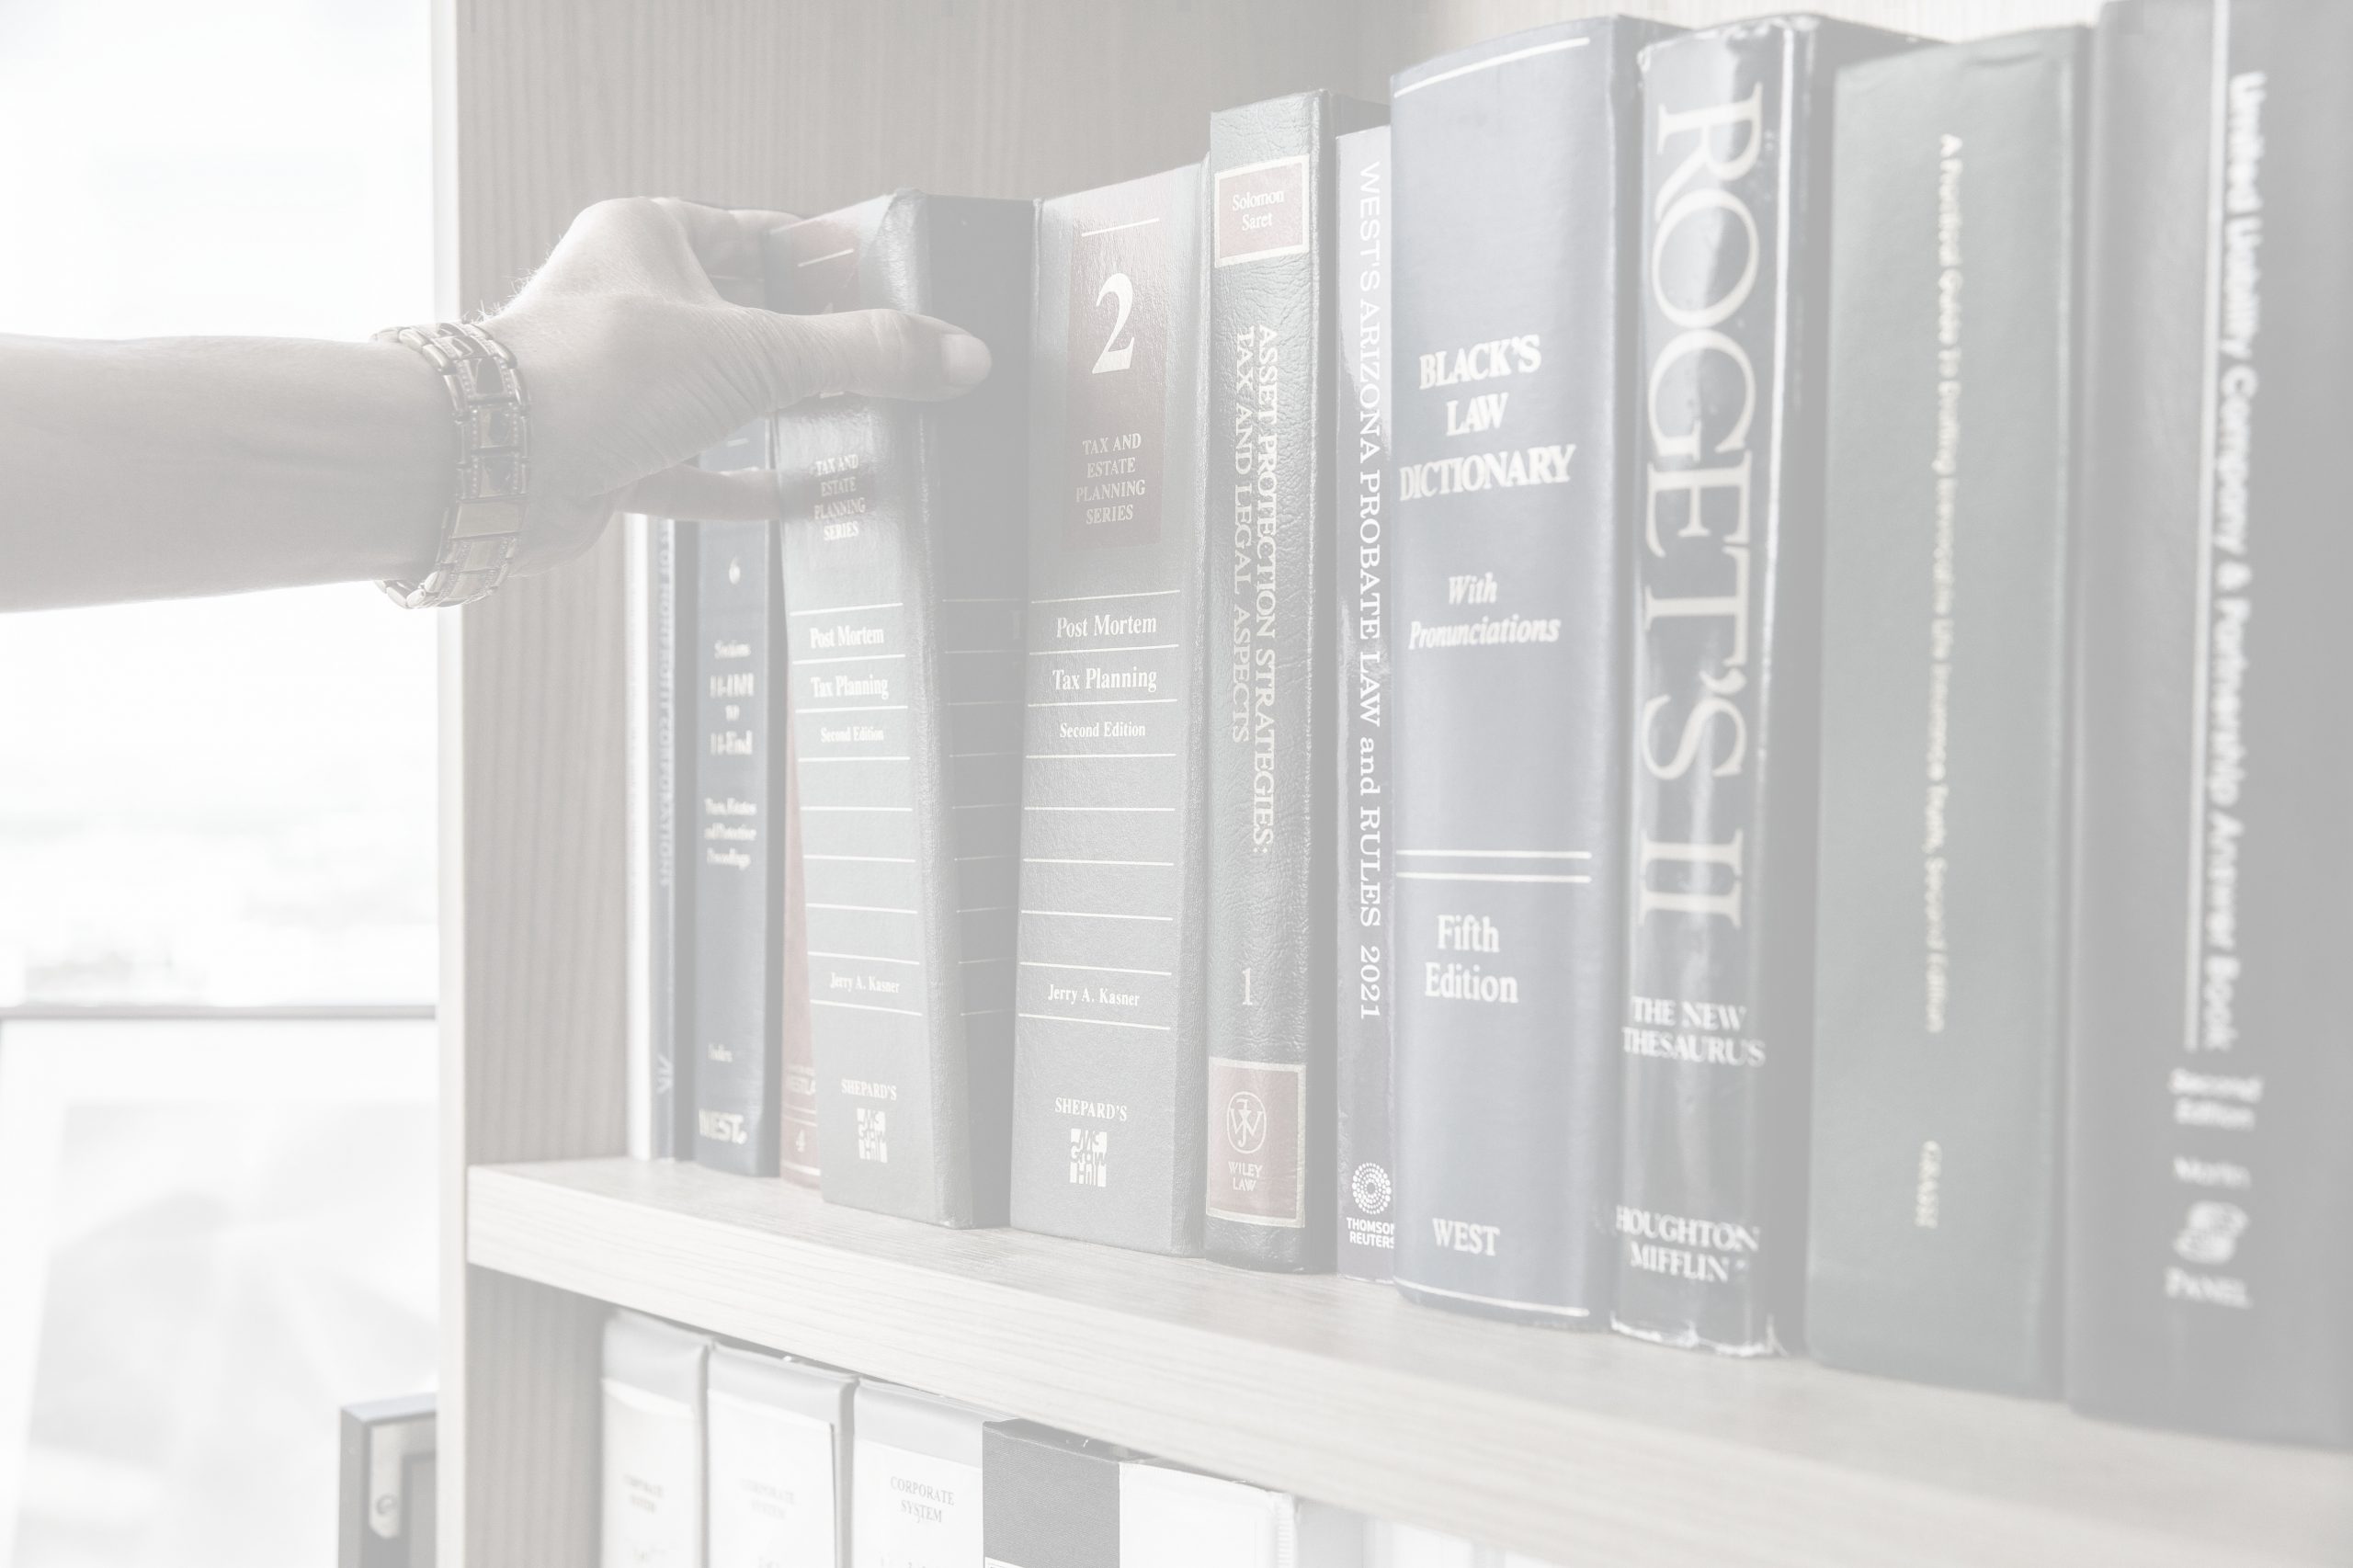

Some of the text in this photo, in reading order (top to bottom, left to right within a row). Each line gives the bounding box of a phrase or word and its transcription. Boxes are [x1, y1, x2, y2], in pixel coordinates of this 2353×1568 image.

[1939, 132, 1963, 158] A
[1232, 190, 1285, 211] Solomon
[1241, 211, 1273, 232] Saret
[1937, 267, 1964, 346] Guide
[1091, 273, 1136, 375] 2
[1418, 333, 1543, 391] BLACK'S
[1445, 392, 1509, 437] LAW
[1082, 432, 1142, 456] TAX AND
[814, 453, 859, 477] TAX AND
[1086, 456, 1136, 480] ESTATE
[1398, 443, 1577, 503] DICTIONARY
[820, 476, 857, 497] ESTATE
[1075, 479, 1146, 504] PLANNING
[813, 496, 866, 521] PLANNING
[1086, 503, 1134, 525] SERIES
[1639, 82, 1763, 929] ROGET'S II
[823, 521, 860, 542] SERIES
[1232, 325, 1256, 744] TAX AND LEGAL ASPECTS
[2202, 71, 2268, 1054] Limited Liability Company & Partnership Answer Book
[1253, 324, 1279, 854] ASSET PROTECTION STRATEGIES:
[1359, 161, 1381, 1021] WEST'S ARIZONA PROBATE LAW and RULES 2021
[1448, 571, 1498, 606] With
[810, 625, 885, 649] Post Mortem
[1056, 614, 1157, 639] Post Mortem
[1407, 612, 1562, 652] Pronunciations
[810, 674, 889, 700] Tax Planning
[1052, 665, 1157, 692] Tax Planning
[820, 725, 885, 744] Second Edition
[1059, 721, 1146, 738] Second Edition
[1924, 856, 1949, 951] Second
[1435, 913, 1501, 954] Fifth
[829, 971, 901, 995] Jerry A. Kasner
[1048, 983, 1141, 1007] Jerry A. Kasner
[1240, 967, 1254, 1006] 1
[1424, 960, 1520, 1005] Edition
[1924, 951, 1949, 1035] Edition
[1631, 994, 1747, 1032] THE NEW
[1621, 1026, 1766, 1068] THESAURUS
[840, 1077, 898, 1103] SHEPARD'S
[1054, 1096, 1128, 1122] SHEPARD'S
[1228, 1162, 1263, 1178] WILEY
[1233, 1176, 1257, 1192] LAW
[1431, 1217, 1501, 1257] WEST
[1615, 1205, 1761, 1253] HOUGHTON
[1630, 1241, 1732, 1283] MIFFLIN
[889, 1474, 955, 1507] CORPORATE
[900, 1498, 943, 1524] SYSTEM
